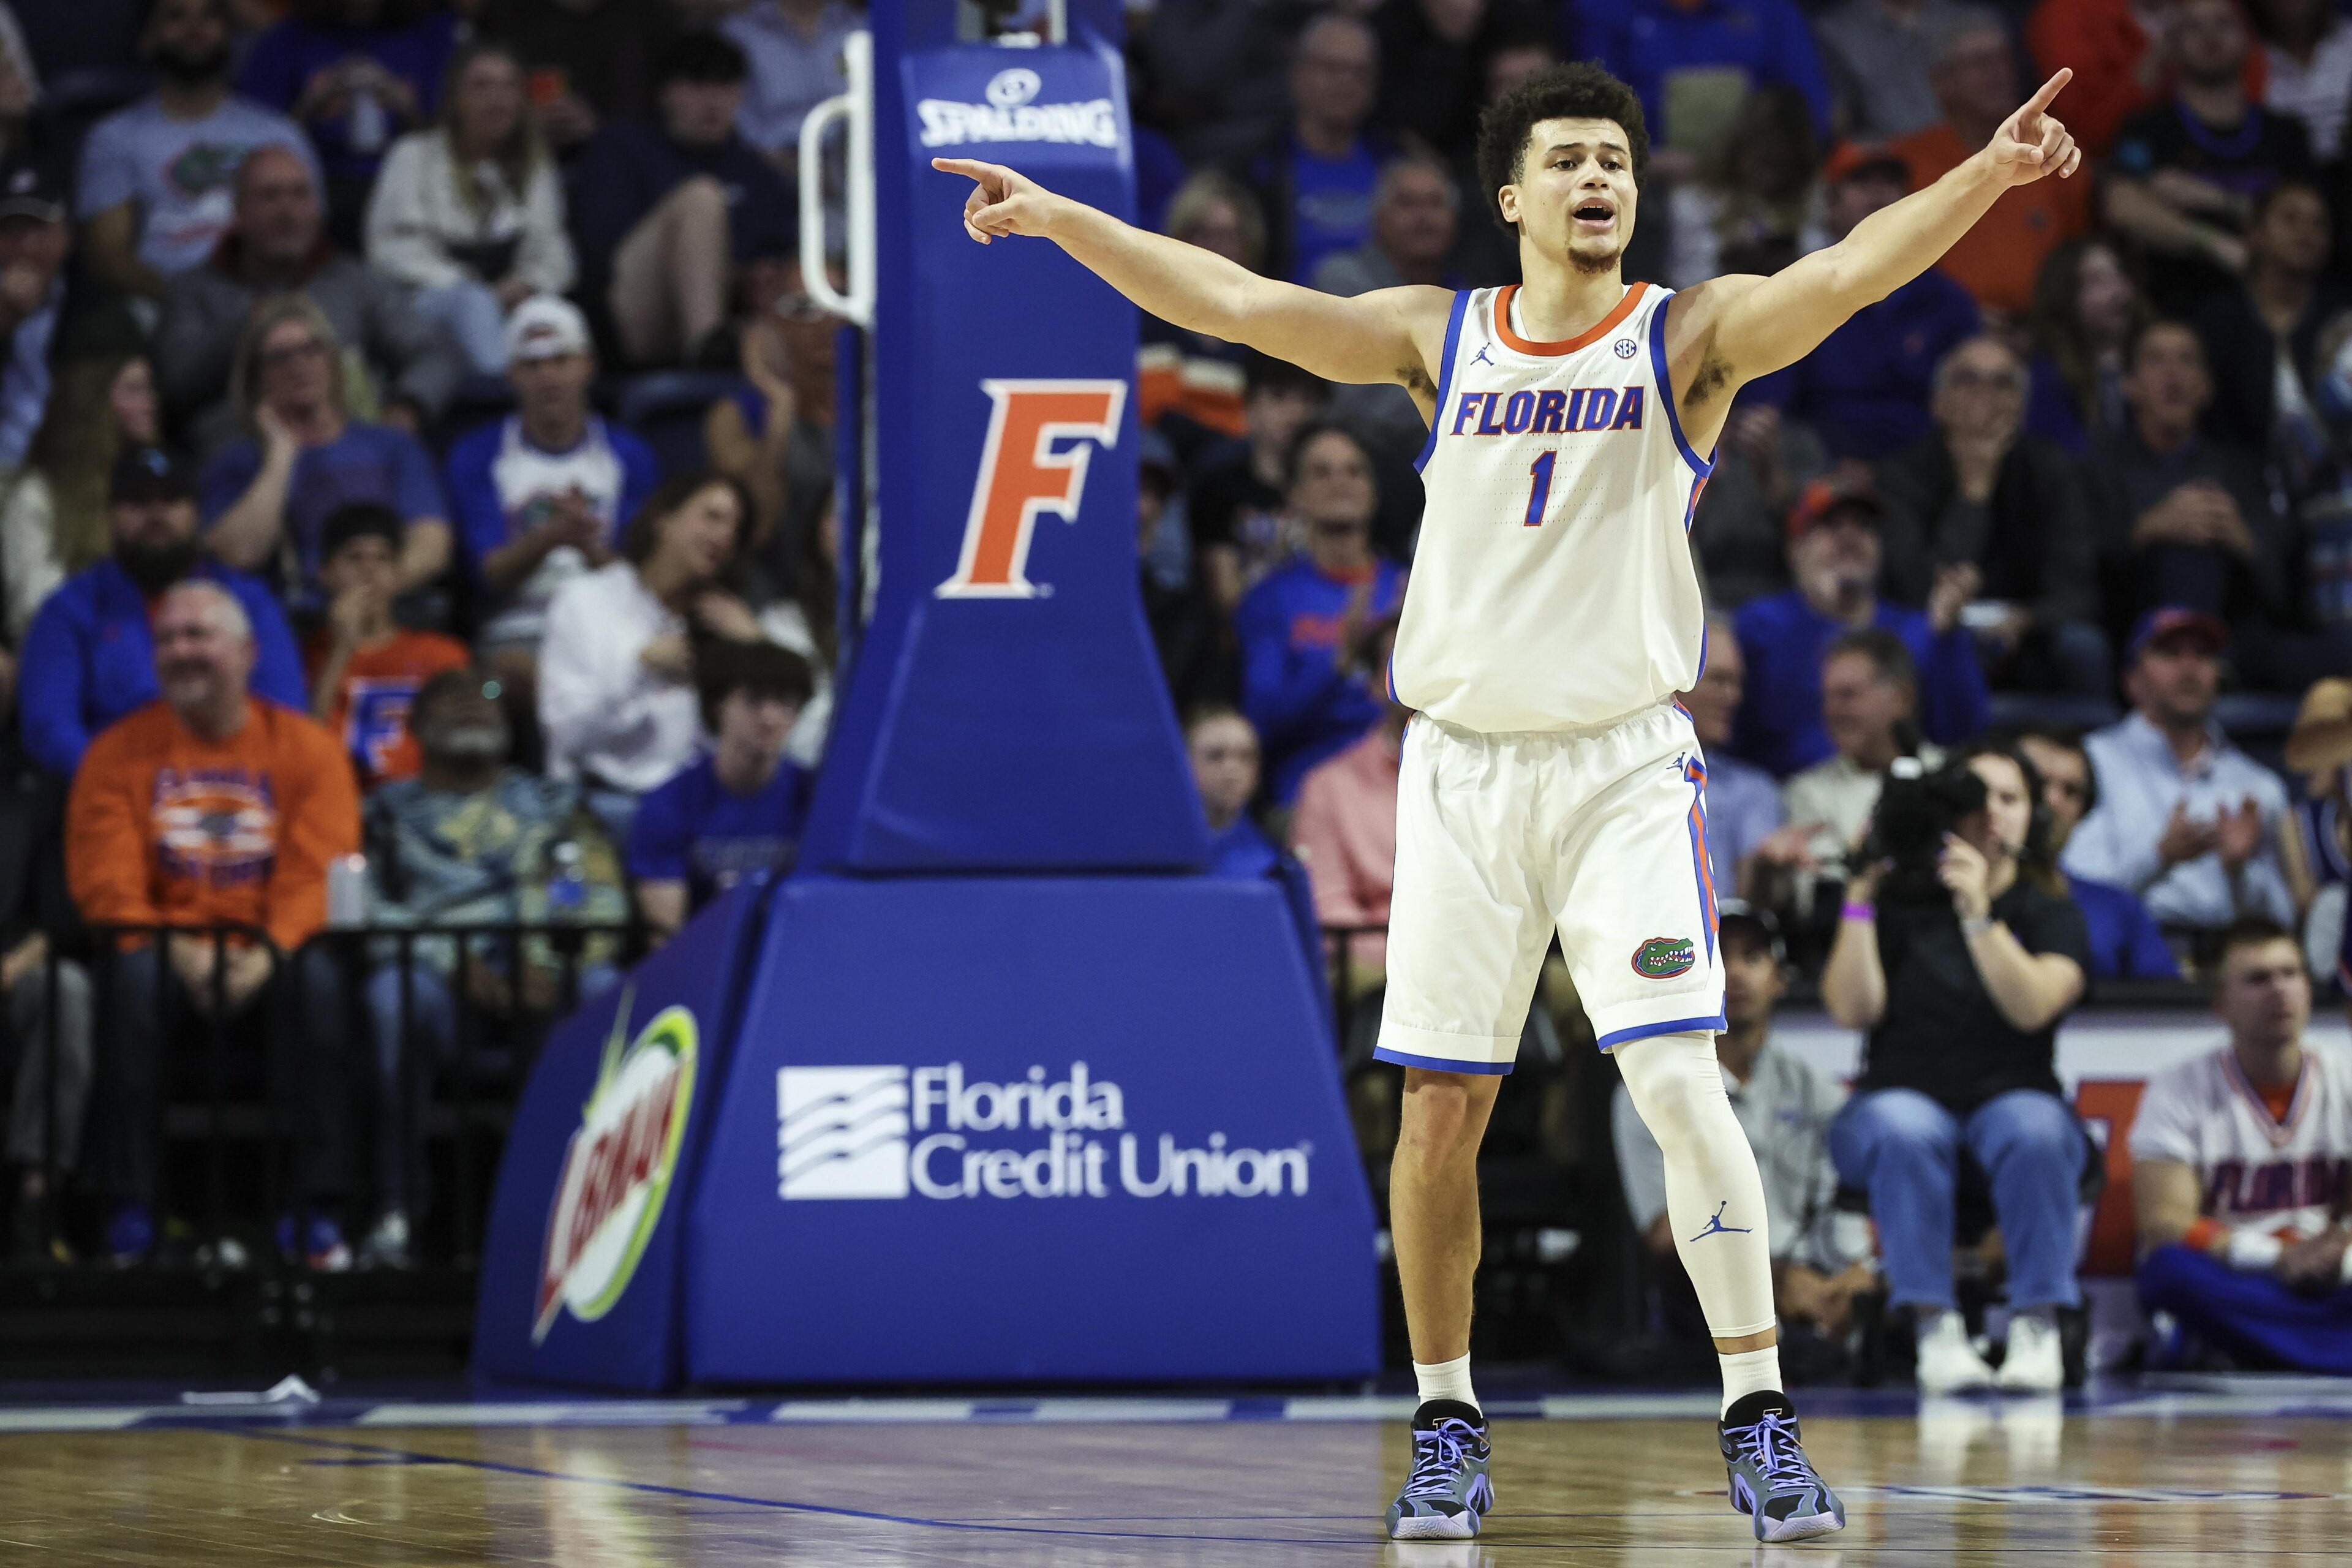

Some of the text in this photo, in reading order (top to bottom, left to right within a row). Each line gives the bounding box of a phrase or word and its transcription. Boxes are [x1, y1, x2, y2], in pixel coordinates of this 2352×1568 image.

[918, 98, 1117, 147] SPALDING
[1616, 340, 1635, 358] SEC
[1450, 386, 1644, 435] FLORIDA
[934, 378, 1128, 599] F
[1523, 450, 1557, 526] 1
[912, 1061, 1125, 1132] Florida
[910, 1131, 1310, 1199] Credit Union
